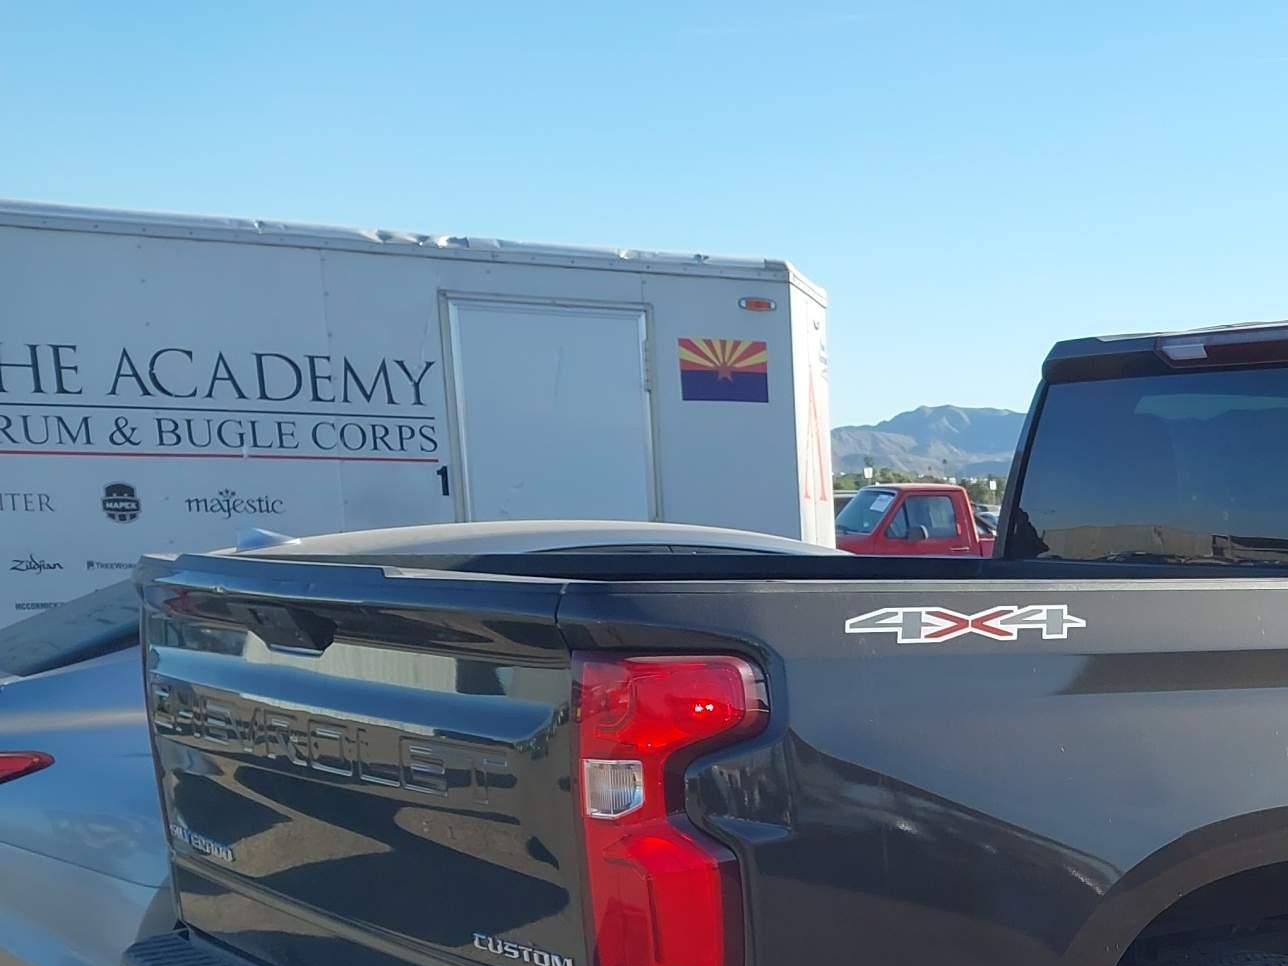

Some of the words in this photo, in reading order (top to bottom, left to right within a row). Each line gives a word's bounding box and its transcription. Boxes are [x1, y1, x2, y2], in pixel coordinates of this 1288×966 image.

[106, 348, 436, 405] ACADEMY
[109, 416, 142, 447] &
[156, 417, 300, 449] BUGLE
[312, 422, 438, 453] CORPS
[436, 465, 449, 496] 1
[186, 494, 283, 519] majestic
[10, 554, 64, 574] Zildjian
